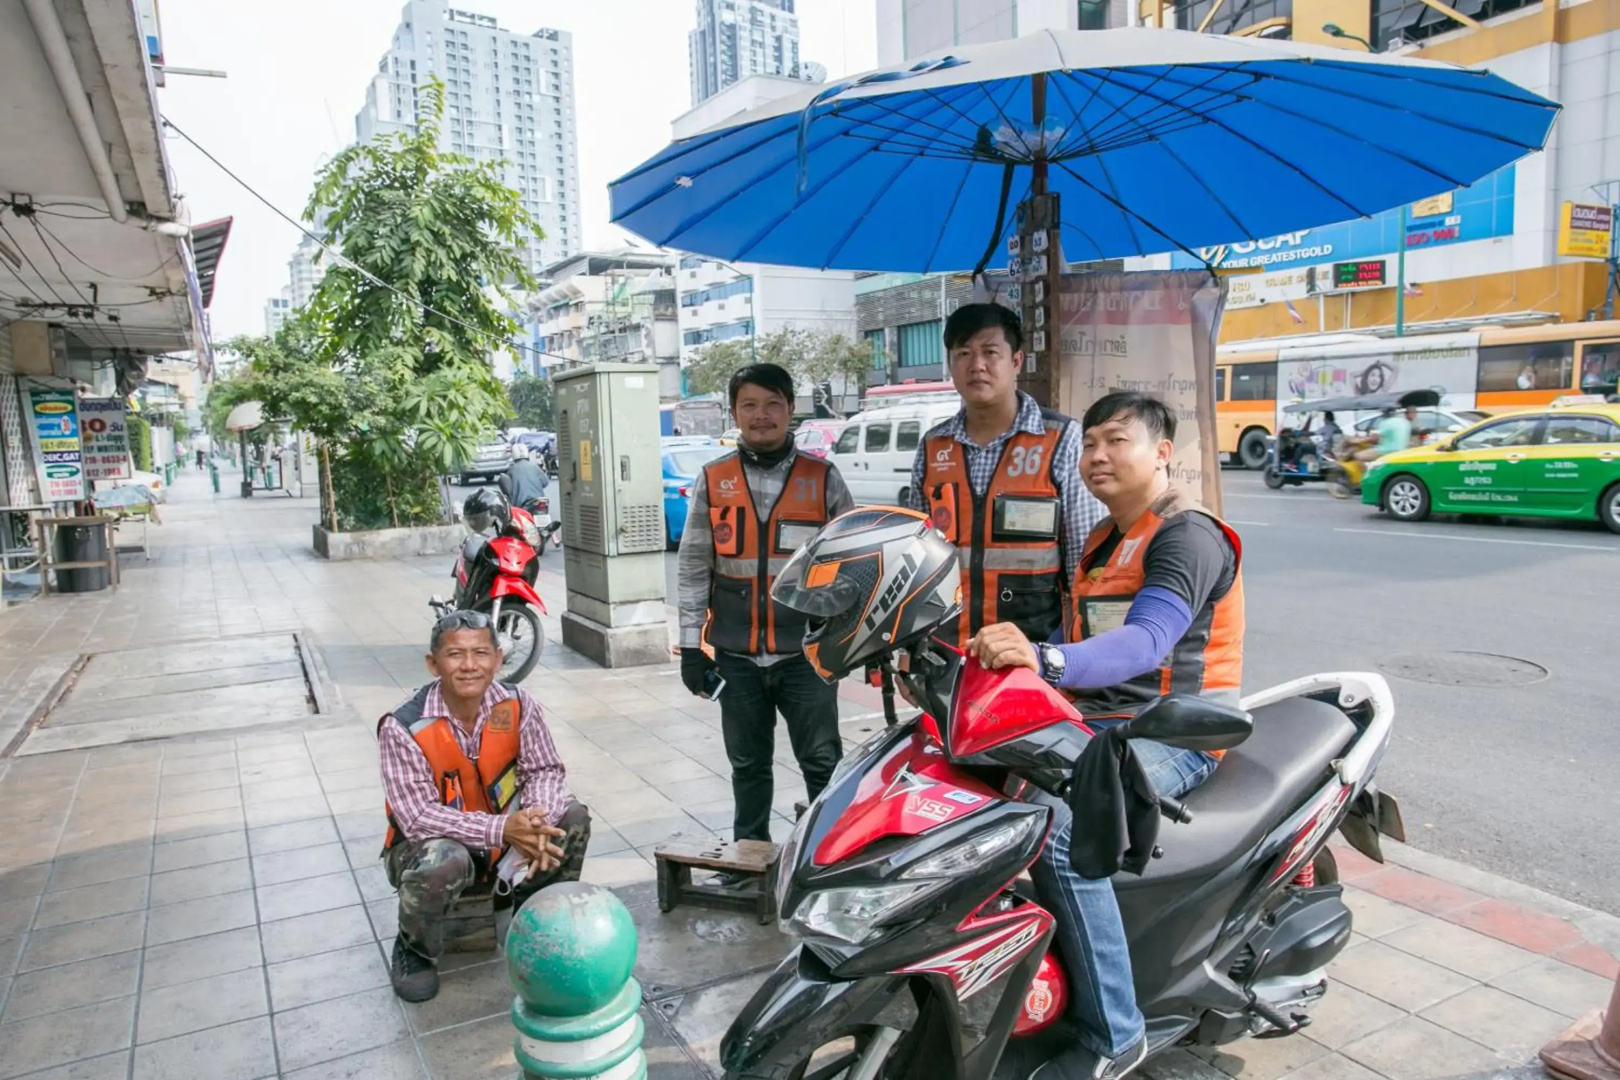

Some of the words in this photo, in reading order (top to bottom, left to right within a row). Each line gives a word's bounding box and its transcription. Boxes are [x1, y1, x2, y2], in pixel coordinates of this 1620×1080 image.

[1222, 257, 1248, 268] YOUR
[1007, 445, 1043, 477] 36
[794, 477, 817, 501] 31
[490, 707, 511, 727] 62
